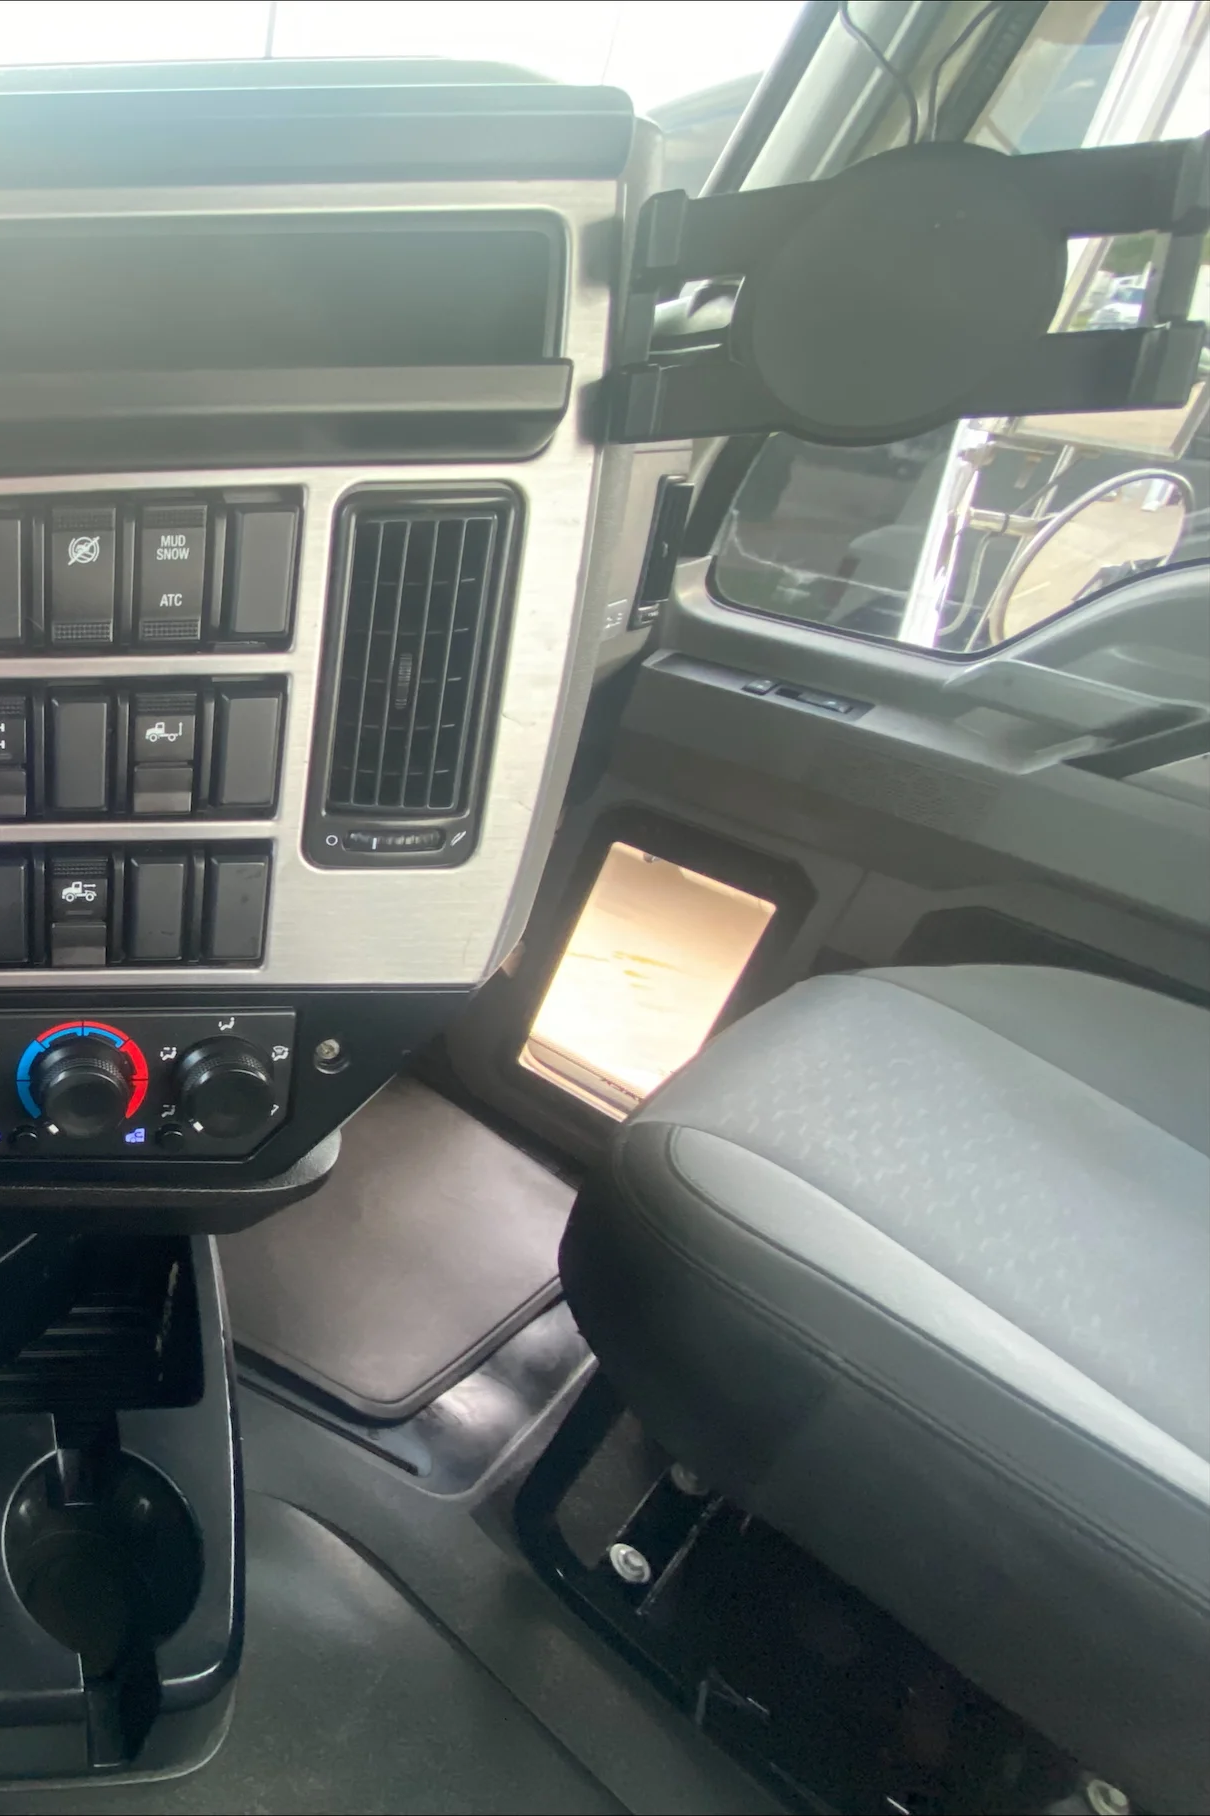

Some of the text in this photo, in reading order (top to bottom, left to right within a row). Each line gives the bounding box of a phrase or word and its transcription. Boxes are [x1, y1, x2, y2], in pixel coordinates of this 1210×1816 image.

[160, 534, 186, 547] MUD
[156, 547, 190, 560] SNOW
[159, 593, 183, 607] ATC
